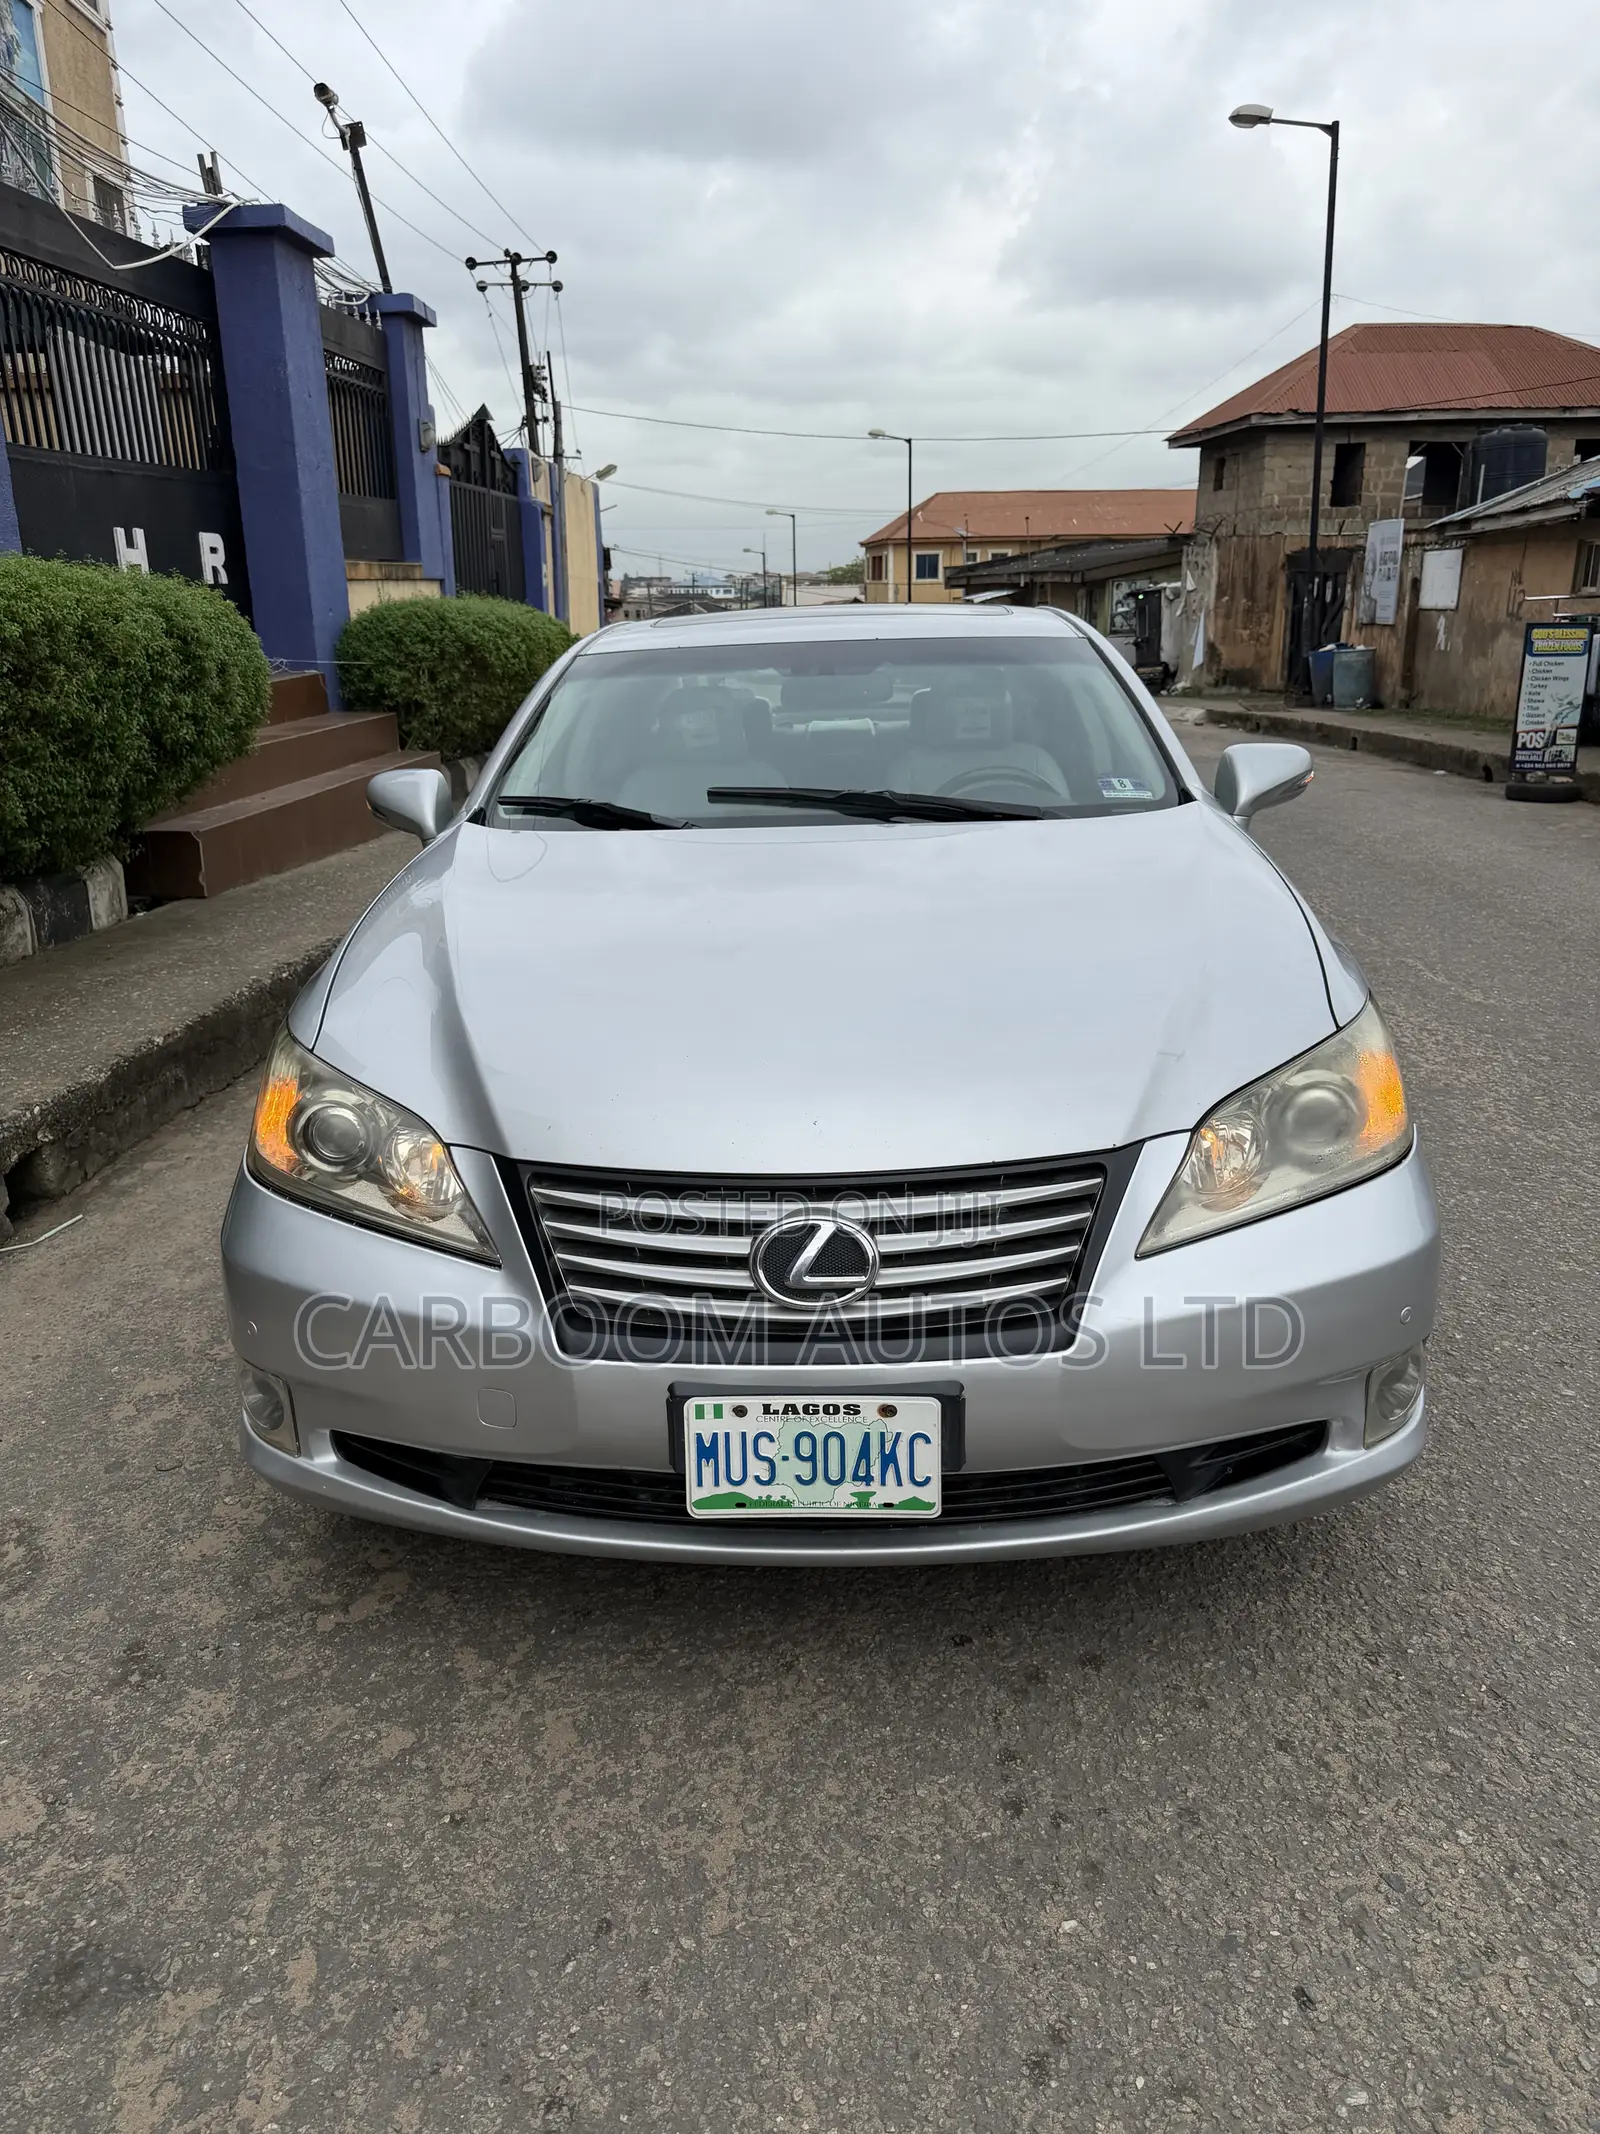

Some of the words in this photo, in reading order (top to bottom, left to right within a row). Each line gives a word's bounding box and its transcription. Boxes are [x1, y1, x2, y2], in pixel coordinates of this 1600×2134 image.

[113, 527, 149, 573] H
[198, 532, 228, 584] R
[1517, 731, 1545, 748] POS
[1117, 779, 1127, 789] 8
[762, 1403, 861, 1416] LAGOS
[696, 1431, 932, 1488] MUS-904KC
